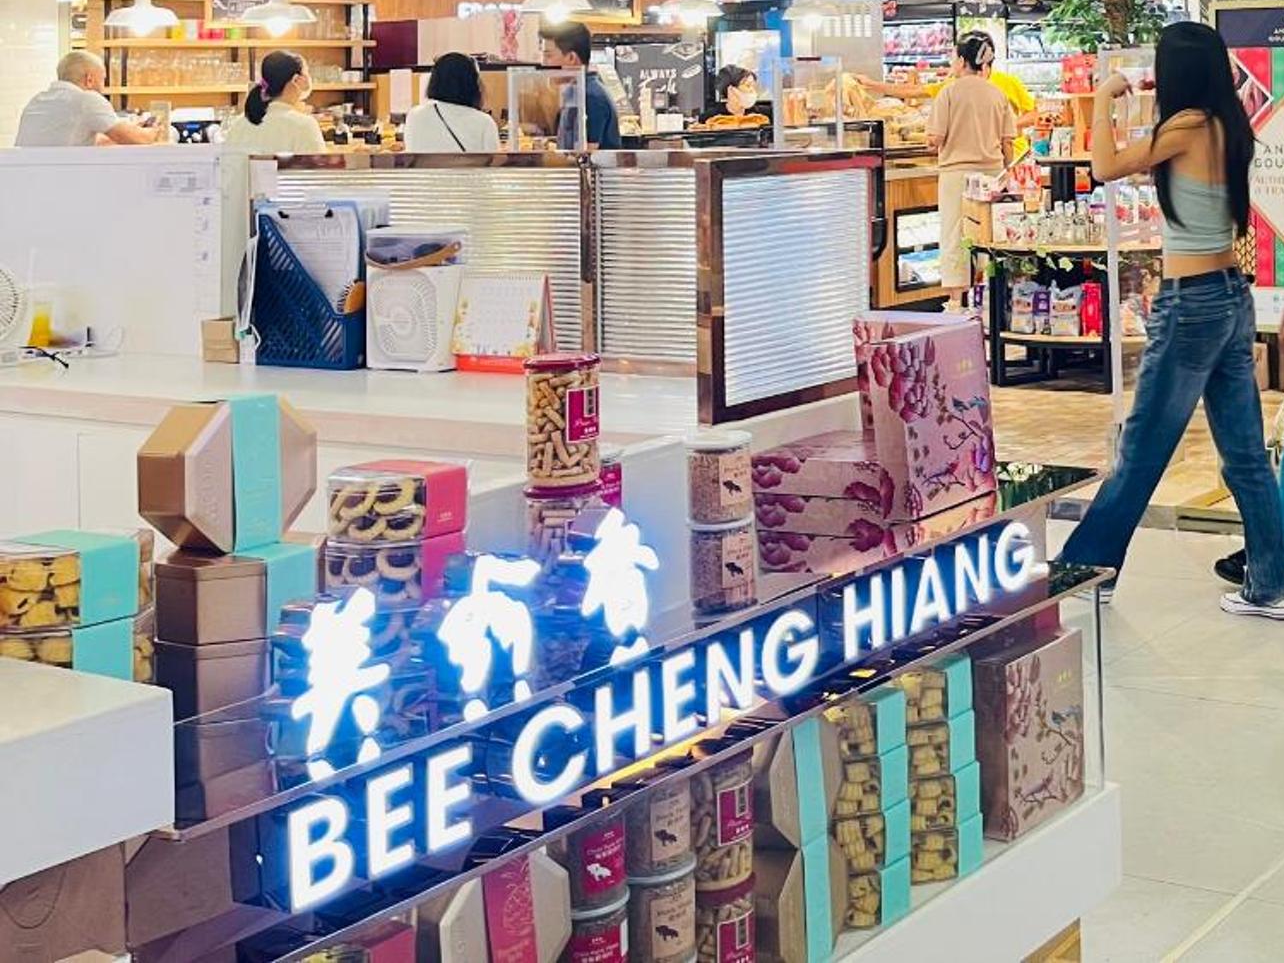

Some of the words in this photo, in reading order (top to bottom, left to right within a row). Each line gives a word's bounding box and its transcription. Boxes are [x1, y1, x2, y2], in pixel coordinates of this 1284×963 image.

[639, 68, 677, 80] ALWAYS
[289, 742, 473, 914] BEE
[511, 609, 820, 805] CHENG
[842, 521, 1038, 664] HIANG
